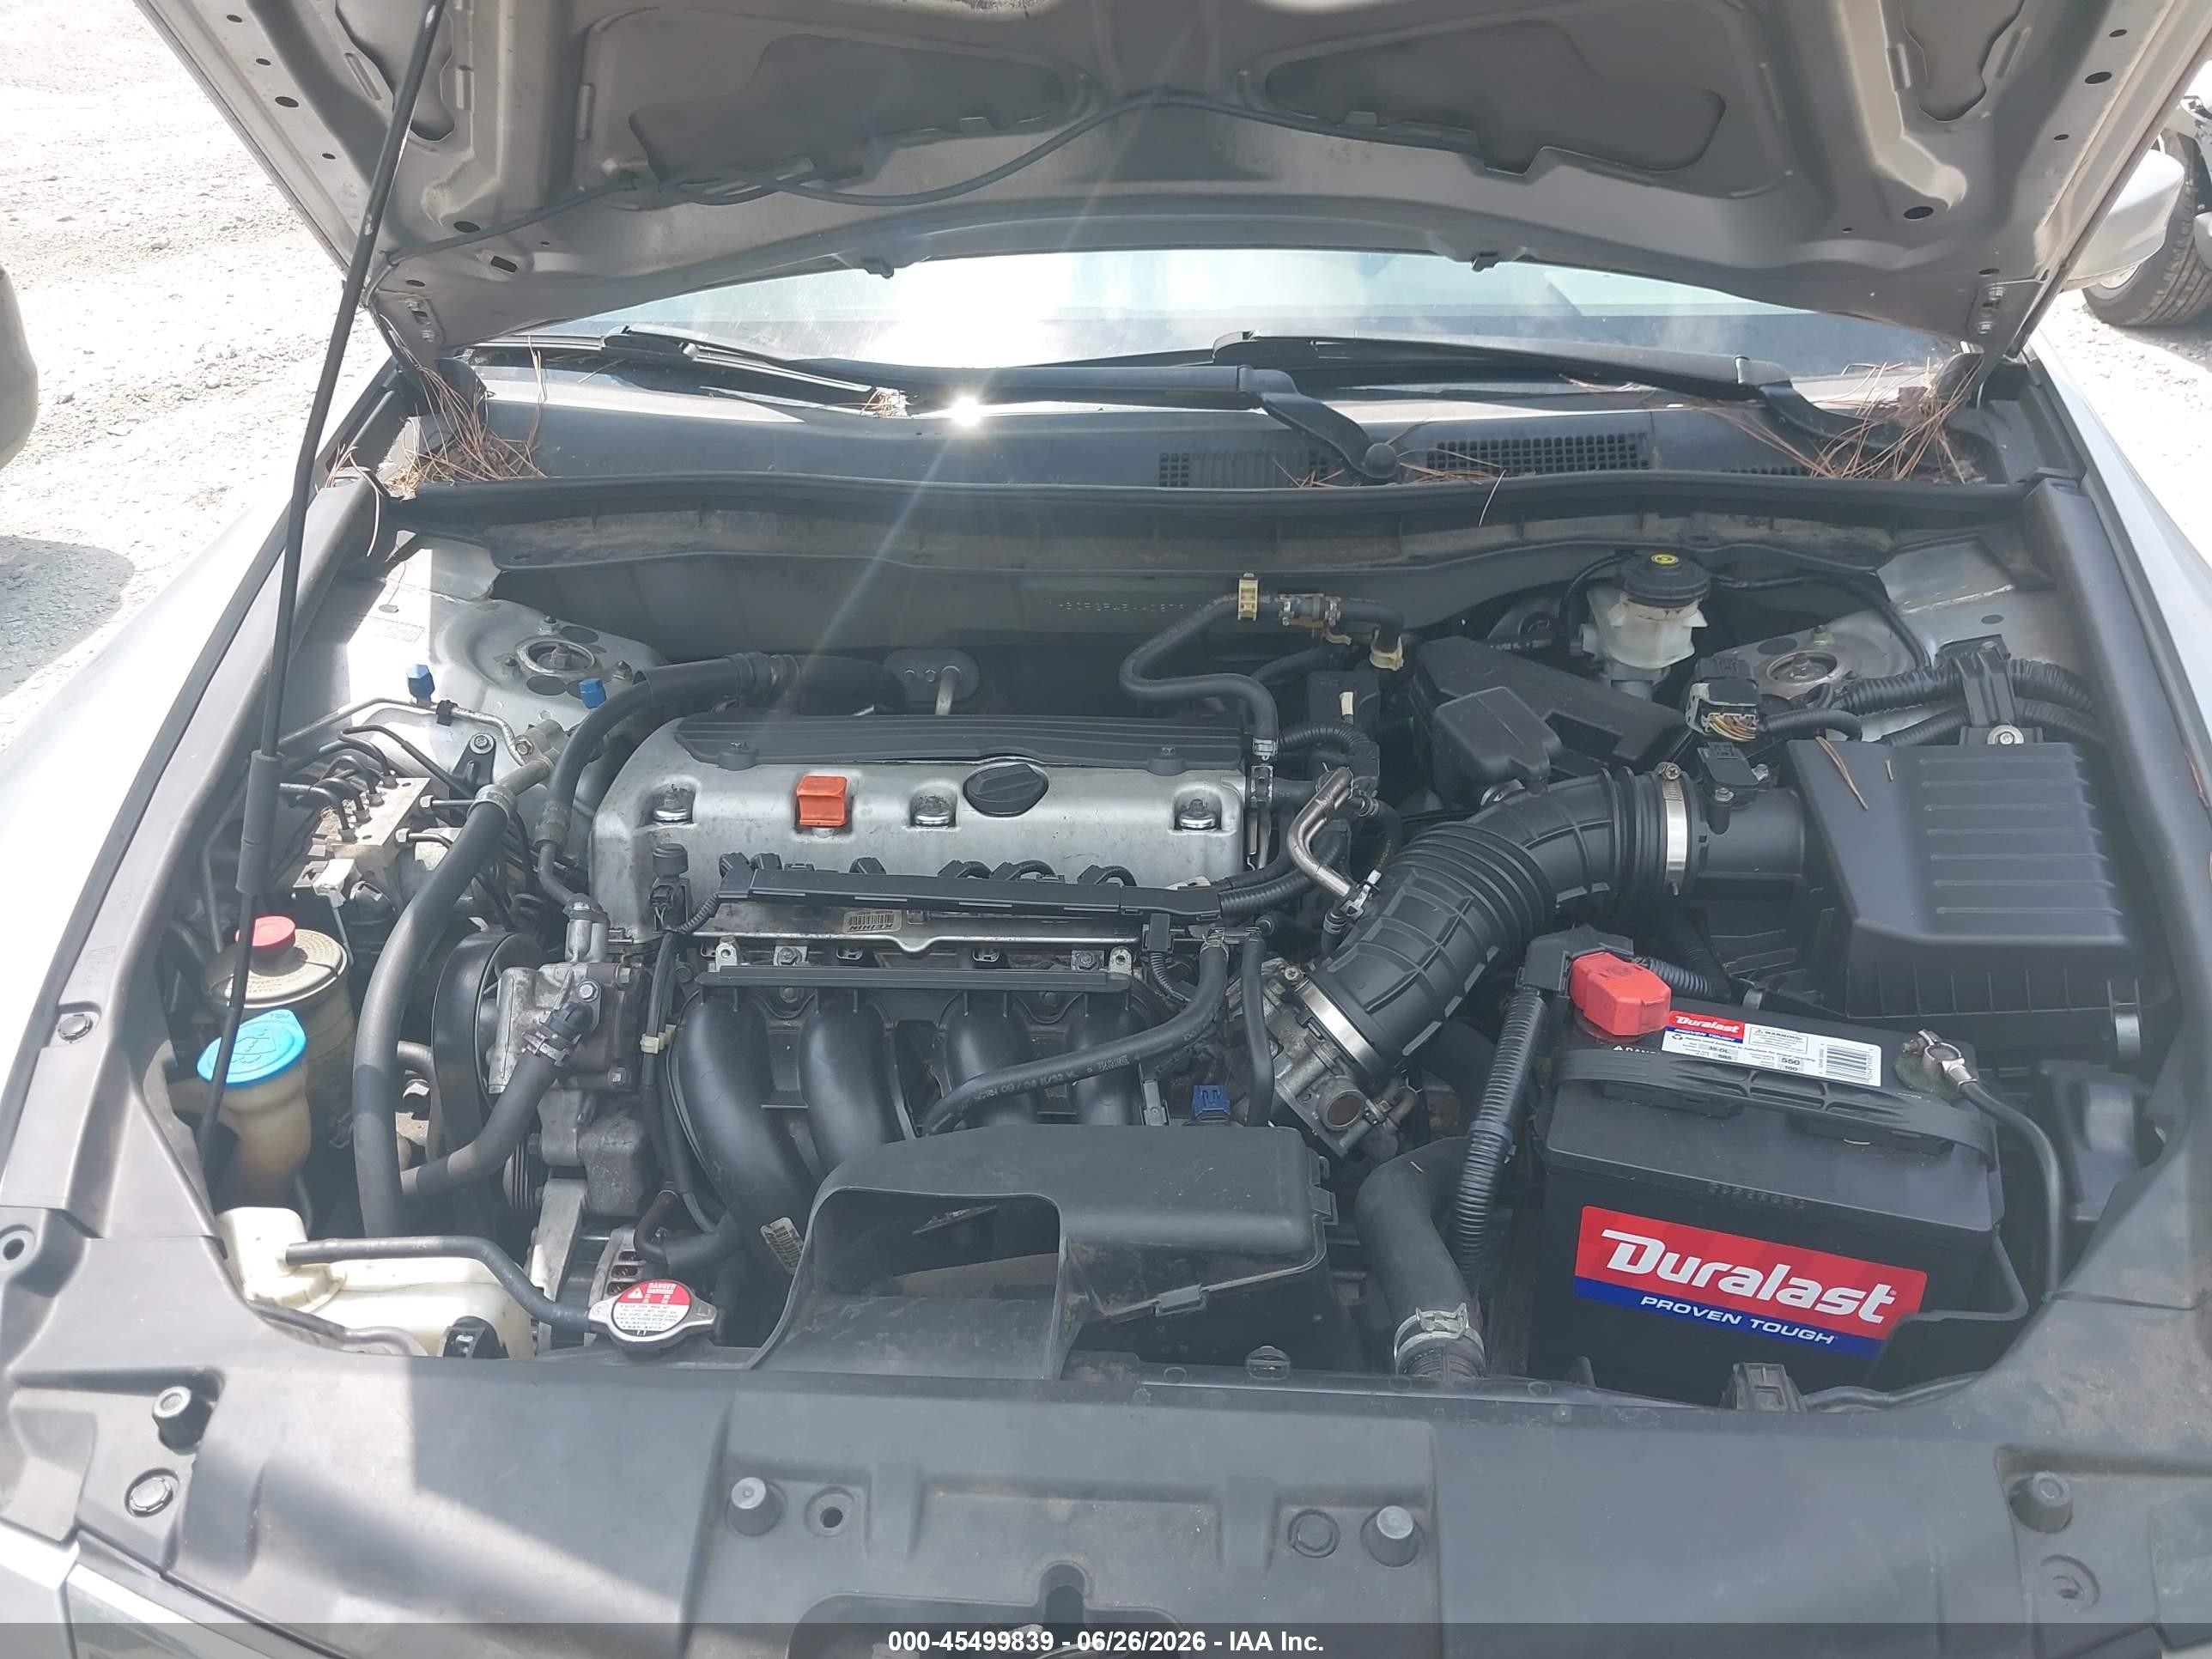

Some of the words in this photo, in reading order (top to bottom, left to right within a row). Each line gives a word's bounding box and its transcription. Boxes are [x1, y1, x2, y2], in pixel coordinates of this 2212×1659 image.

[1675, 1016, 1740, 1033] Duralast
[1781, 1057, 1801, 1066] 550
[1601, 1229, 1896, 1323] Duralast
[1640, 1295, 1742, 1325] PROVEN
[1750, 1318, 1834, 1345] TOUGH
